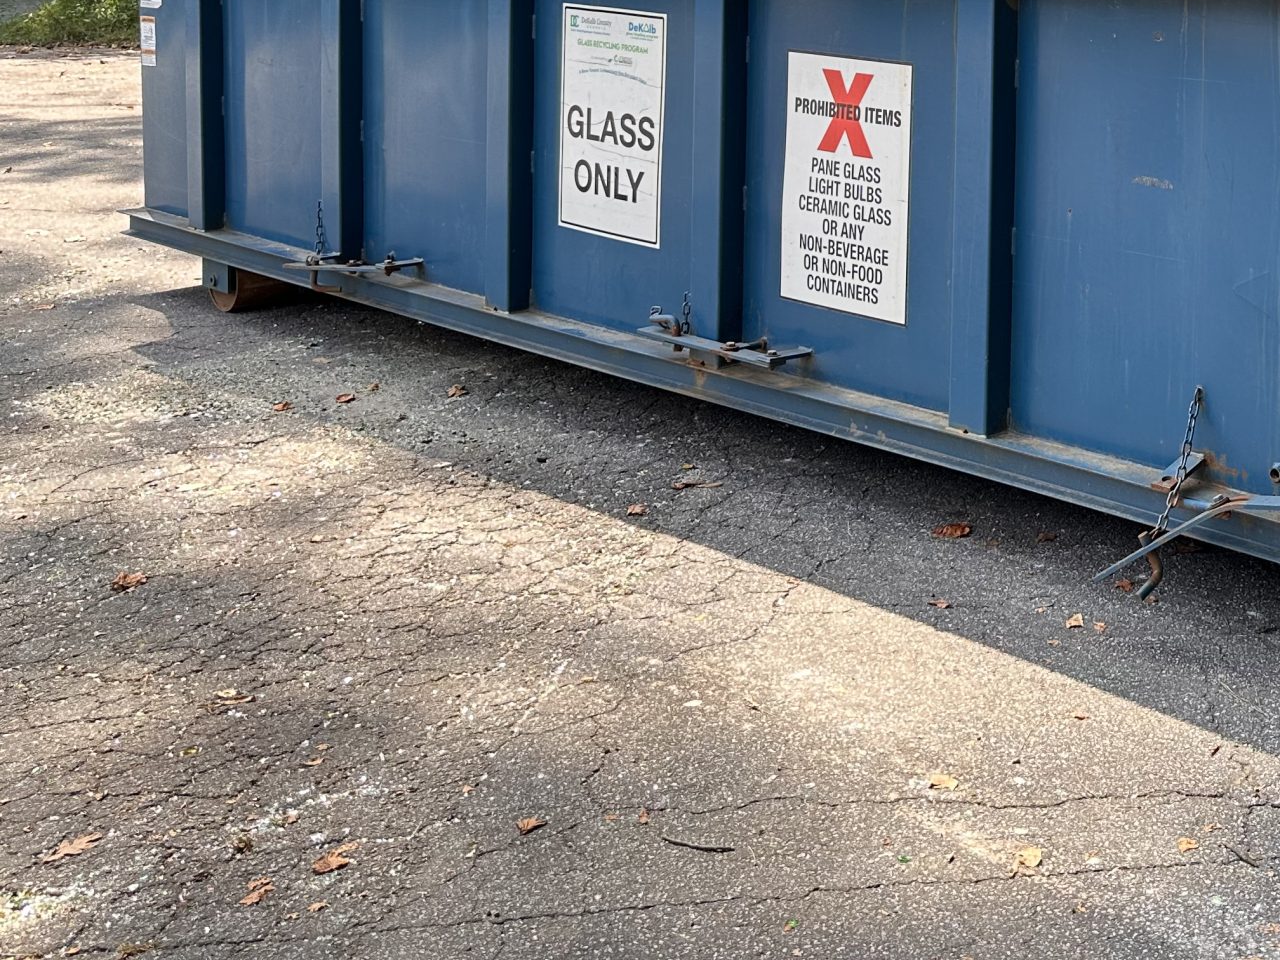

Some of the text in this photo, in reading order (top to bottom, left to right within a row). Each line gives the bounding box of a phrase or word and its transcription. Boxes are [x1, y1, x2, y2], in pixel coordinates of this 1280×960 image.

[577, 38, 648, 54] GLASS RECYCLING PROGRAM
[794, 96, 902, 127] PROHIBITED ITEMS
[567, 104, 655, 151] GLASS
[574, 159, 645, 204] ONLY
[811, 157, 881, 184] PANE GLASS
[808, 176, 882, 204] LIGHT BULBS
[799, 194, 891, 226] CERAMIC GLASS
[822, 218, 865, 241] OR ANY
[799, 233, 889, 266] NON-BEVERAGE
[803, 254, 883, 285] OR NON-FOOD
[806, 274, 879, 305] CONTAINERS
